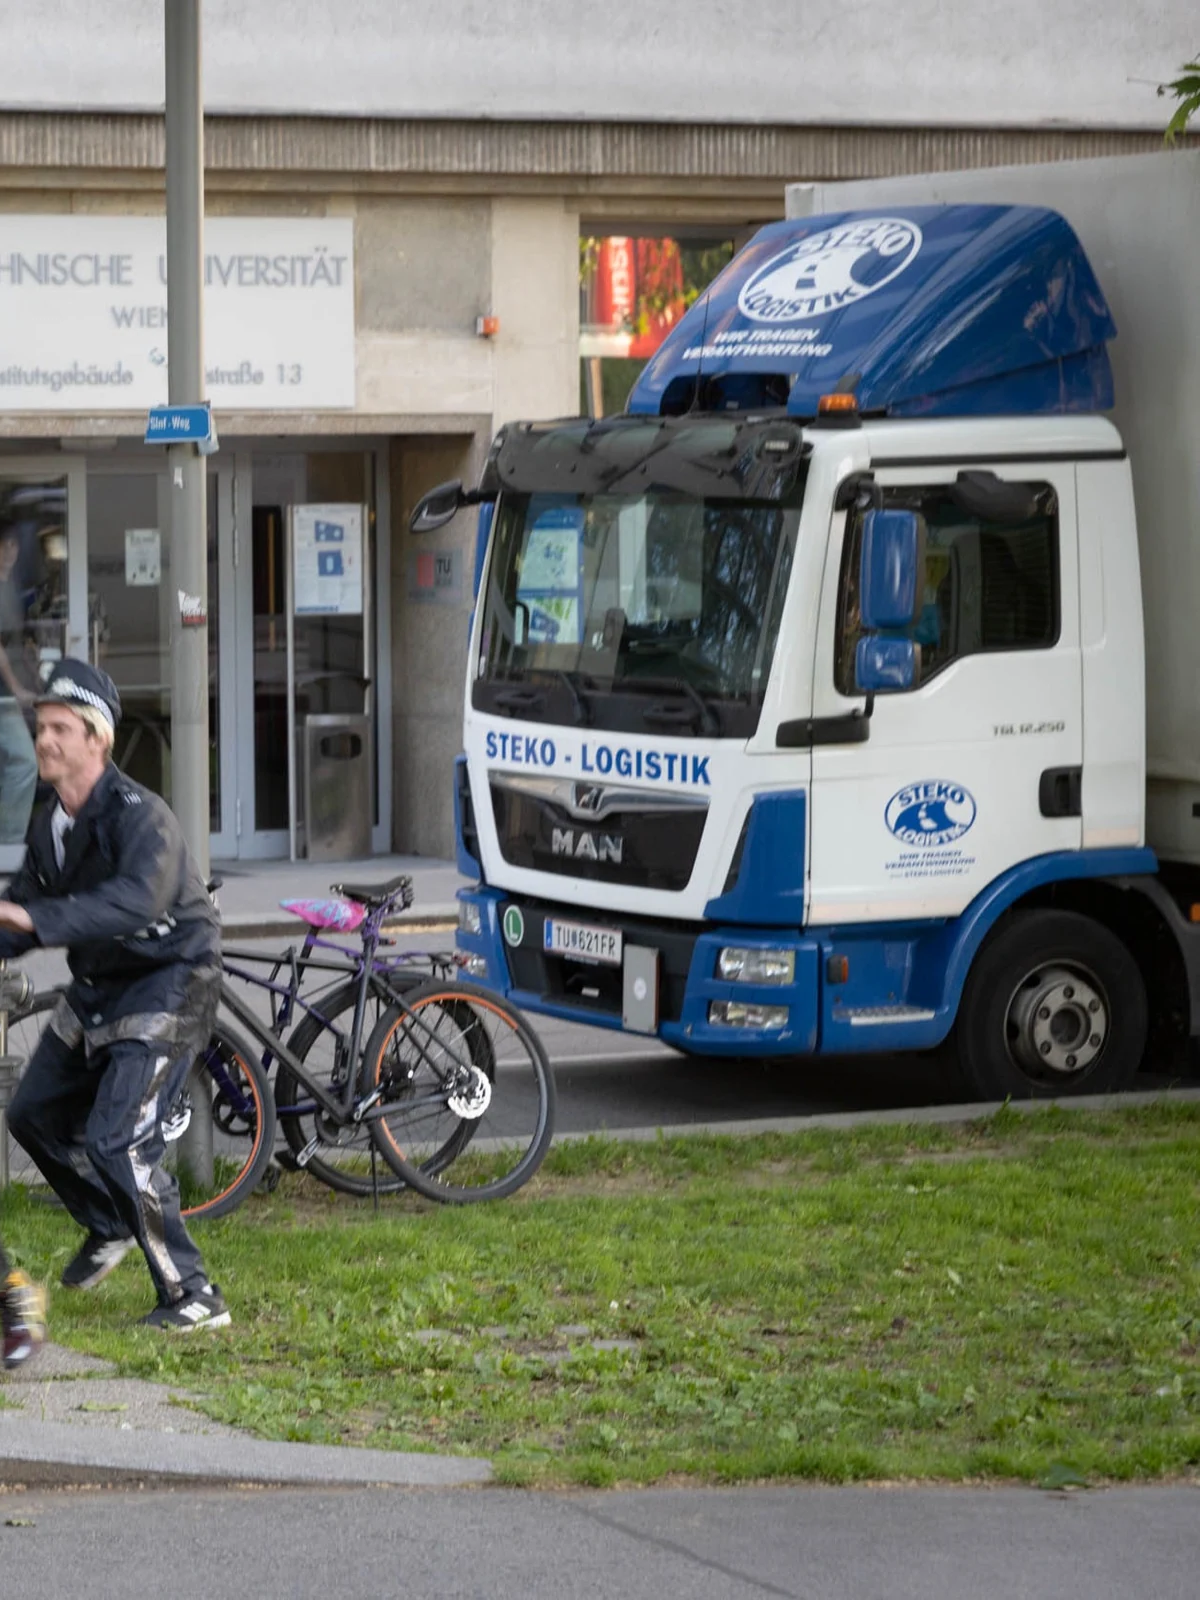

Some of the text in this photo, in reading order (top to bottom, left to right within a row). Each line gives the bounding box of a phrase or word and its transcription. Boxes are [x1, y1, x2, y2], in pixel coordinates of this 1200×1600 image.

[791, 220, 914, 259] STEKO
[744, 284, 862, 318] LOGISTIK
[749, 327, 821, 342] TRAGEN
[436, 558, 451, 574] TU
[486, 731, 557, 767] STEKO
[580, 743, 712, 786] LOGISTIK
[898, 783, 965, 808] STEKO
[551, 827, 624, 865] MAN
[893, 823, 969, 847] LOGISTIK
[508, 913, 519, 939] L
[555, 925, 572, 948] TU
